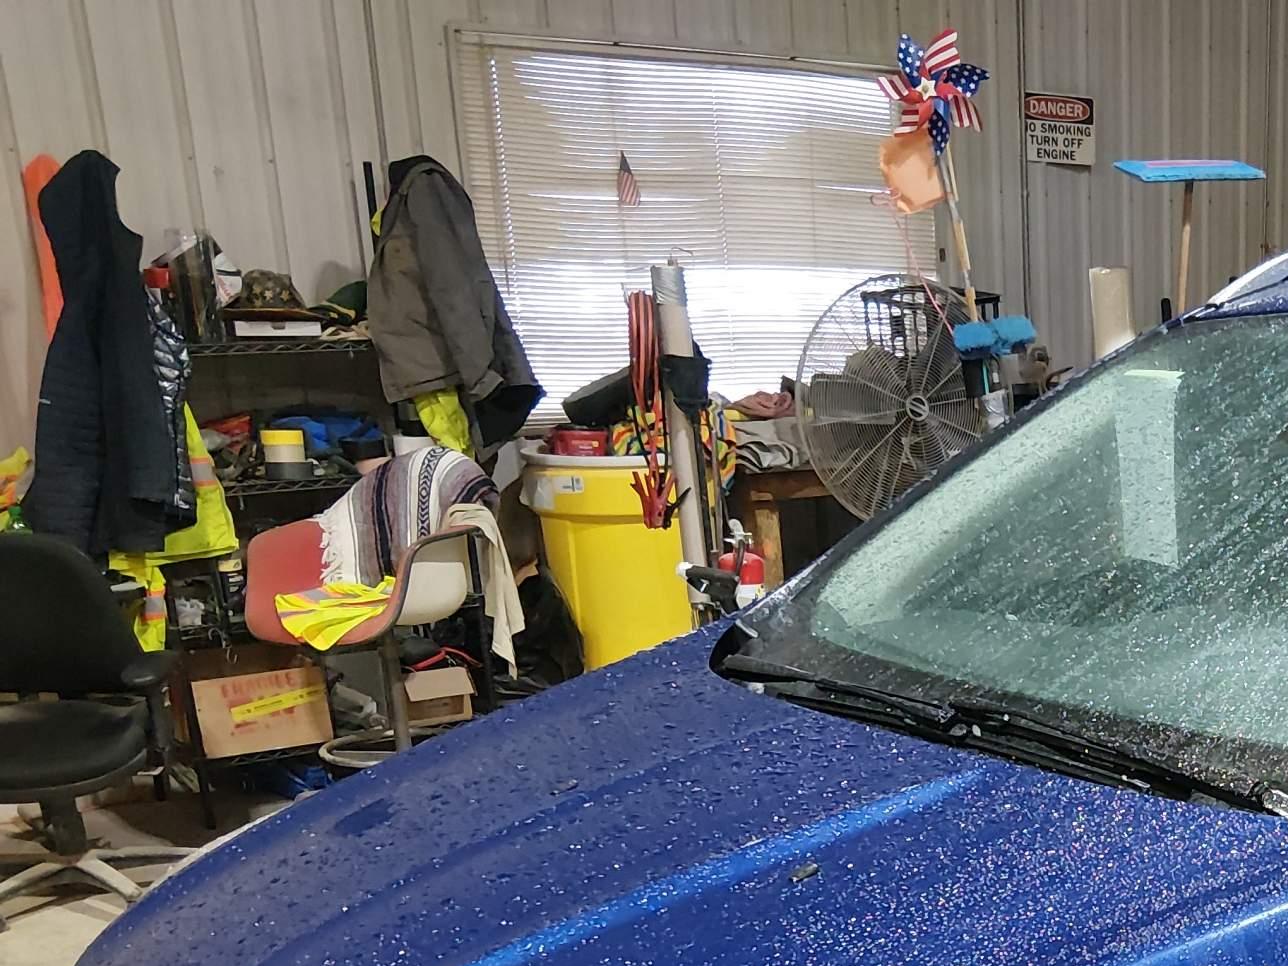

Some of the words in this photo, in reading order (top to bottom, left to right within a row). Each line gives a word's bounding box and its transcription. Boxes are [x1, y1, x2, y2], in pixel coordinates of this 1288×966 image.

[1029, 100, 1083, 118] DANGER
[1040, 122, 1092, 138] SMOKING
[1029, 134, 1059, 148] TURN
[1063, 137, 1084, 149] OFF
[1036, 147, 1077, 161] ENGINE
